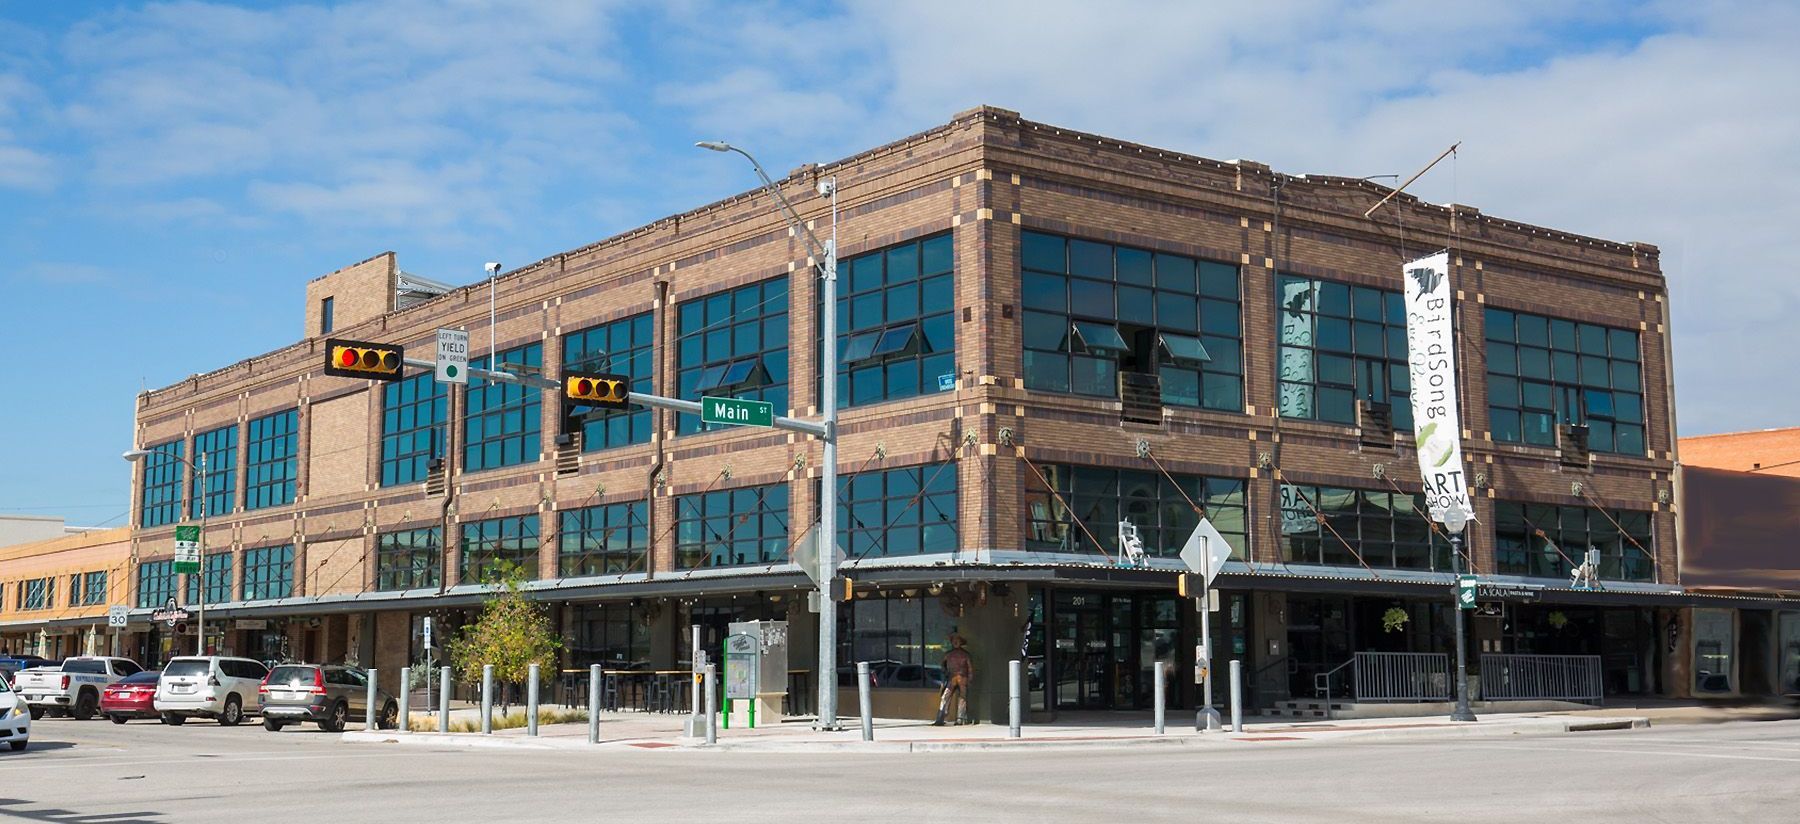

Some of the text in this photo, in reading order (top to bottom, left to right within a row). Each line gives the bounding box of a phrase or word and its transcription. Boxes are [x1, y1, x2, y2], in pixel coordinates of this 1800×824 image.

[441, 342, 465, 353] YIELD
[1426, 298, 1448, 419] BirdSong
[715, 403, 768, 420] Main ST
[1423, 471, 1462, 495] ART
[1478, 588, 1488, 597] LA
[1489, 588, 1509, 598] SCALA
[1072, 597, 1085, 606] 201
[111, 615, 126, 625] 30
